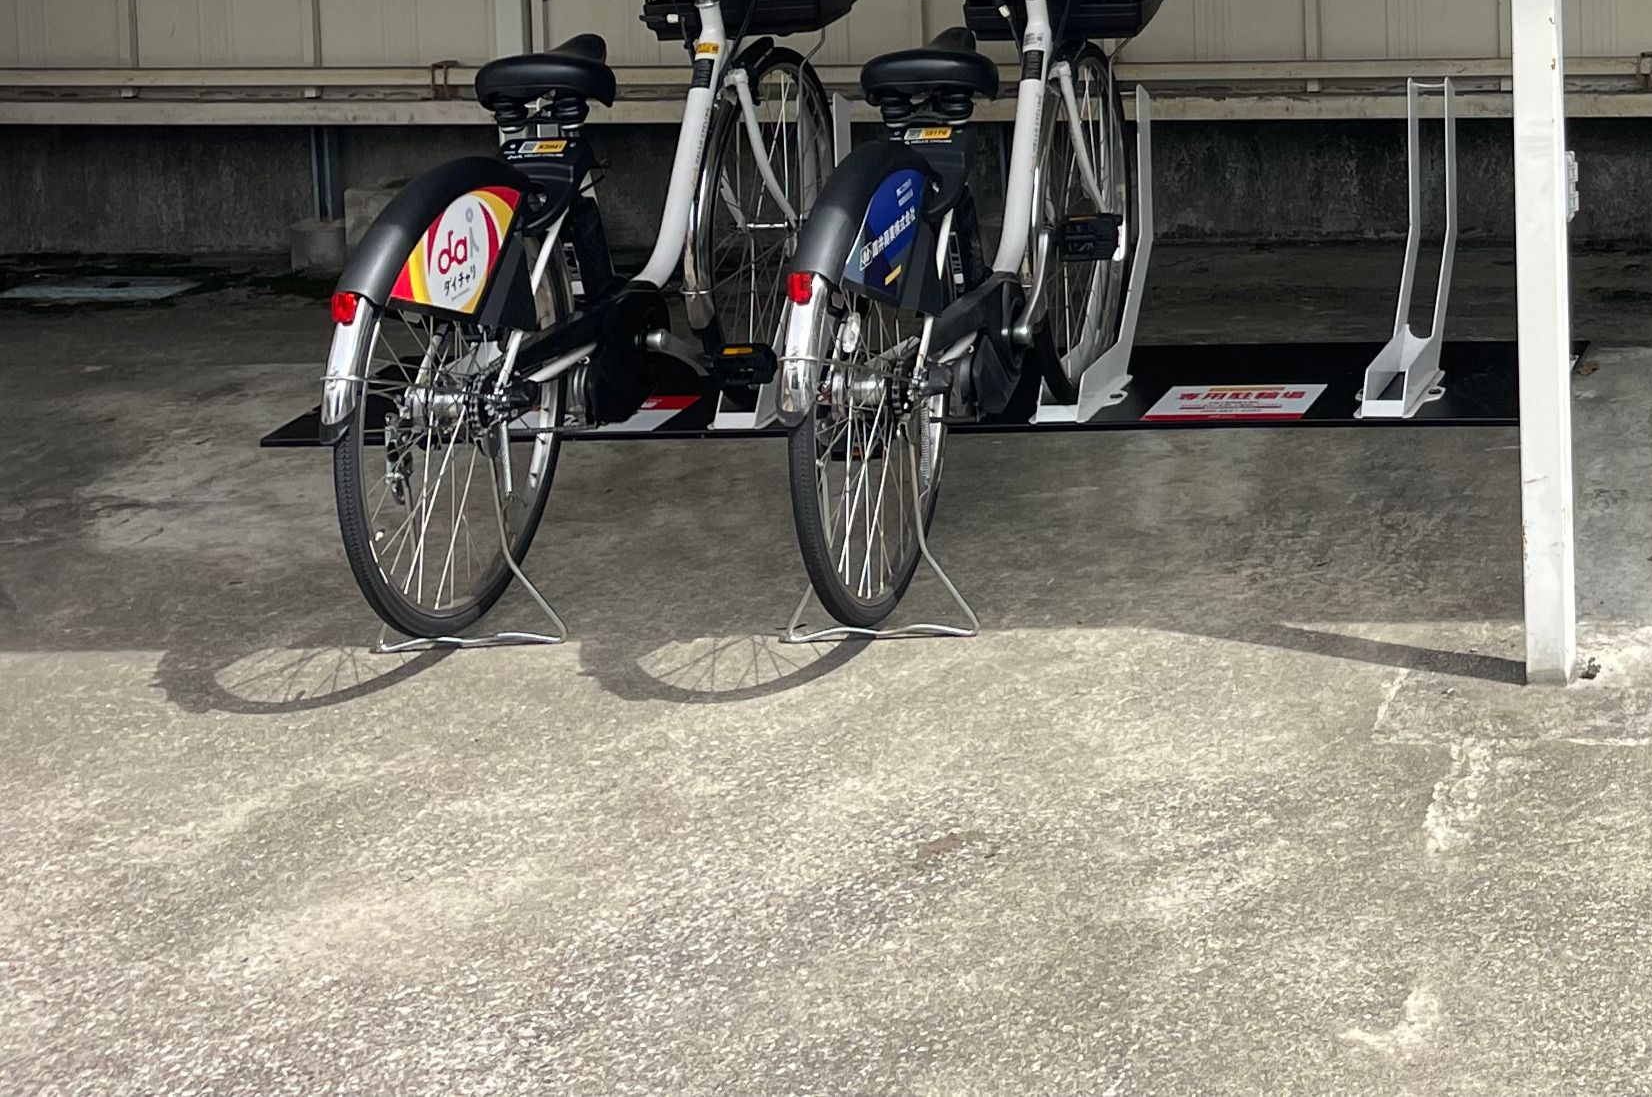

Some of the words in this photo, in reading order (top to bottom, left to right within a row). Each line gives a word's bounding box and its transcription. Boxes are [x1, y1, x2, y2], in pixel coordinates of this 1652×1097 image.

[437, 207, 480, 275] dai
[443, 264, 477, 297] ダイチャリ
